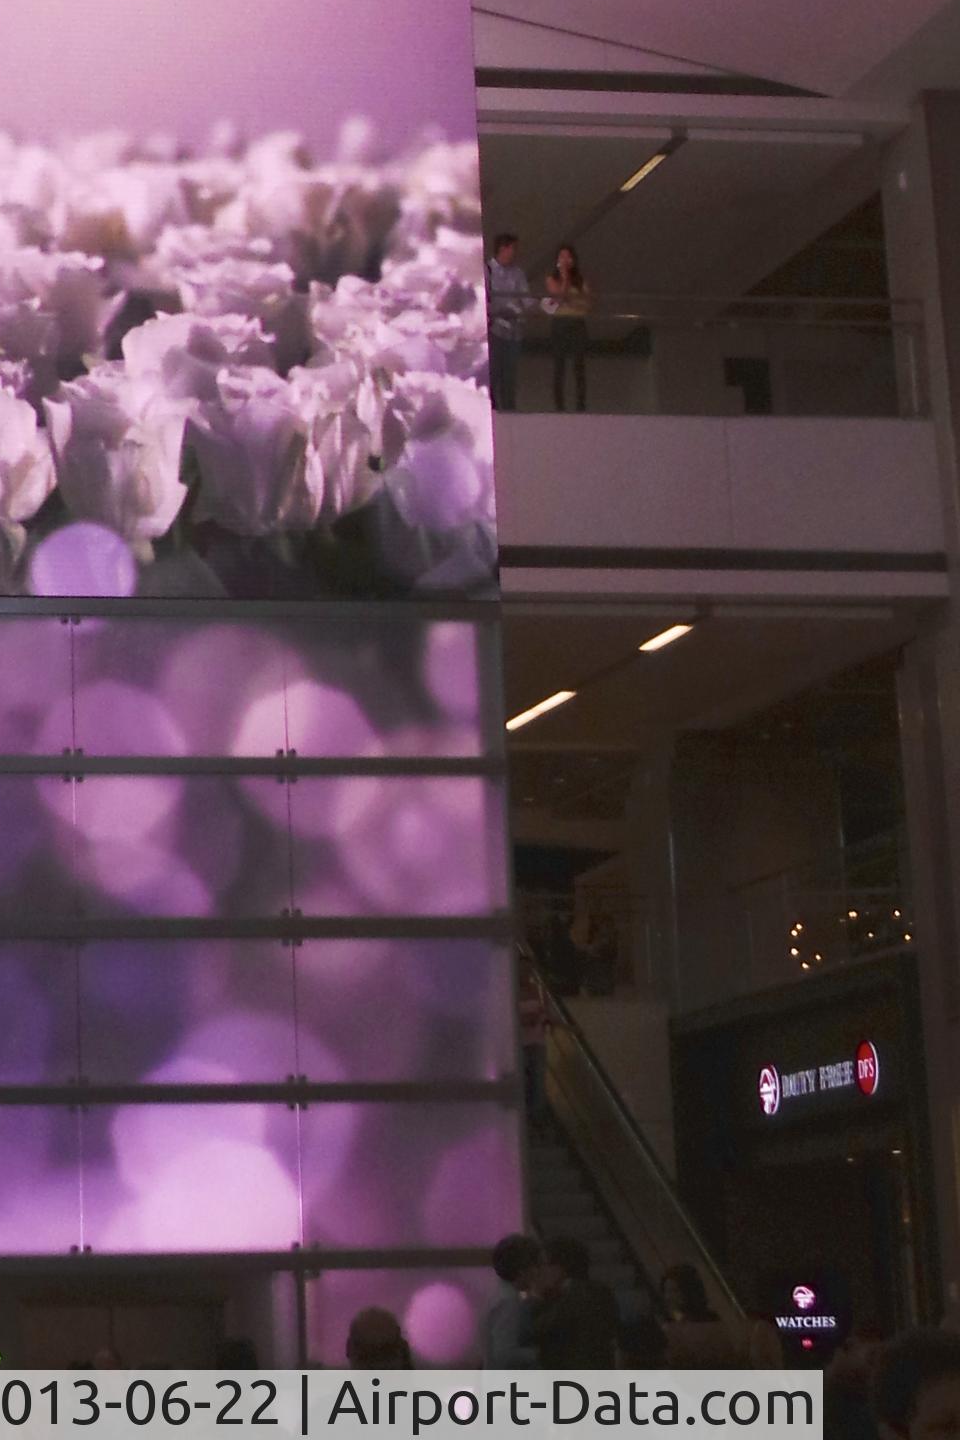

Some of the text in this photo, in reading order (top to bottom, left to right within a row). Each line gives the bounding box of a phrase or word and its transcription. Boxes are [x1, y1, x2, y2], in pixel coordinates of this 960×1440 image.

[858, 1058, 875, 1079] DFS
[781, 1069, 816, 1098] DUTY
[775, 1315, 836, 1328] WATCHES
